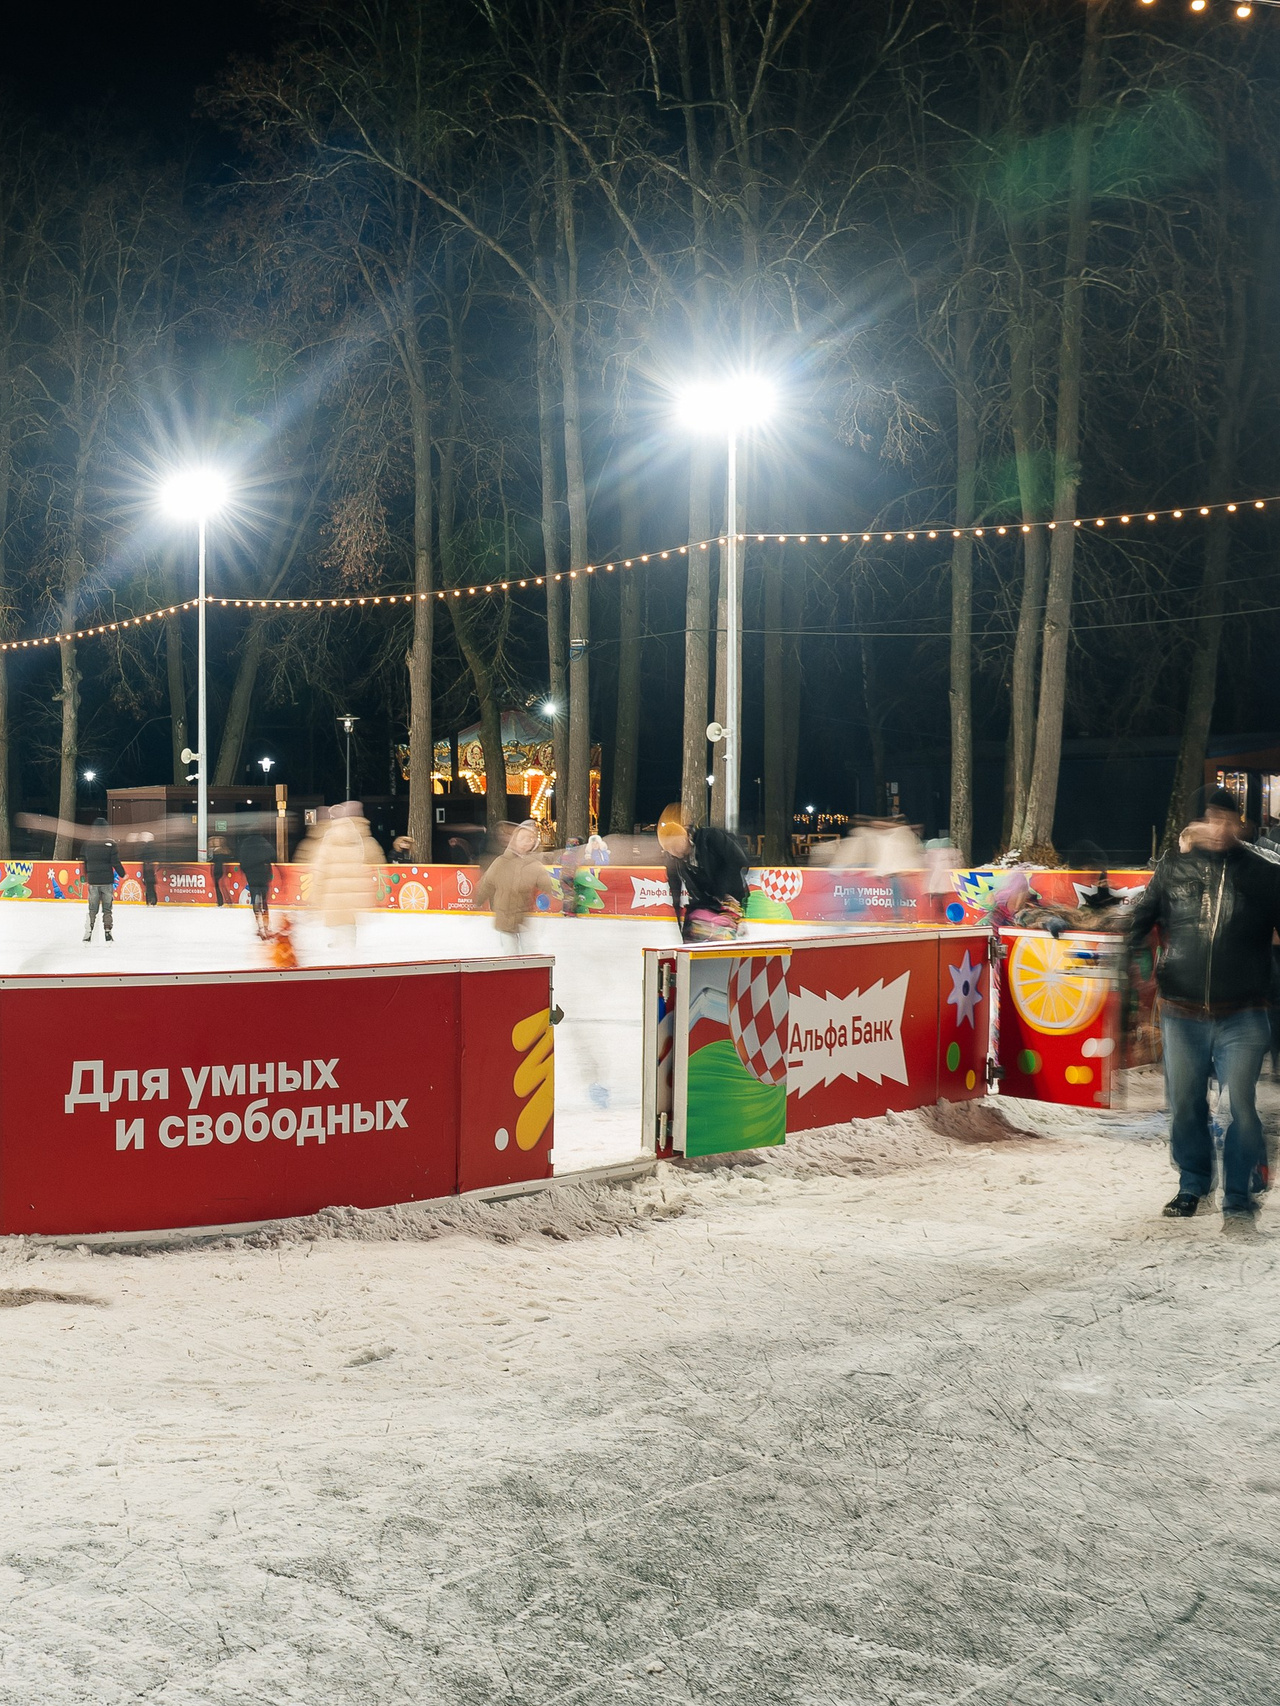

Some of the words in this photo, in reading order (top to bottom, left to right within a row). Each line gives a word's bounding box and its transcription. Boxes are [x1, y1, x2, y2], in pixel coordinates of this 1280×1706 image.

[640, 887, 667, 898] Альфа
[833, 886, 855, 897] Для
[788, 1019, 848, 1058] Альфа
[851, 1015, 894, 1045] Банк
[64, 1060, 169, 1113] Для
[181, 1058, 340, 1109] умных
[115, 1118, 144, 1150] и
[158, 1098, 409, 1148] свободных
